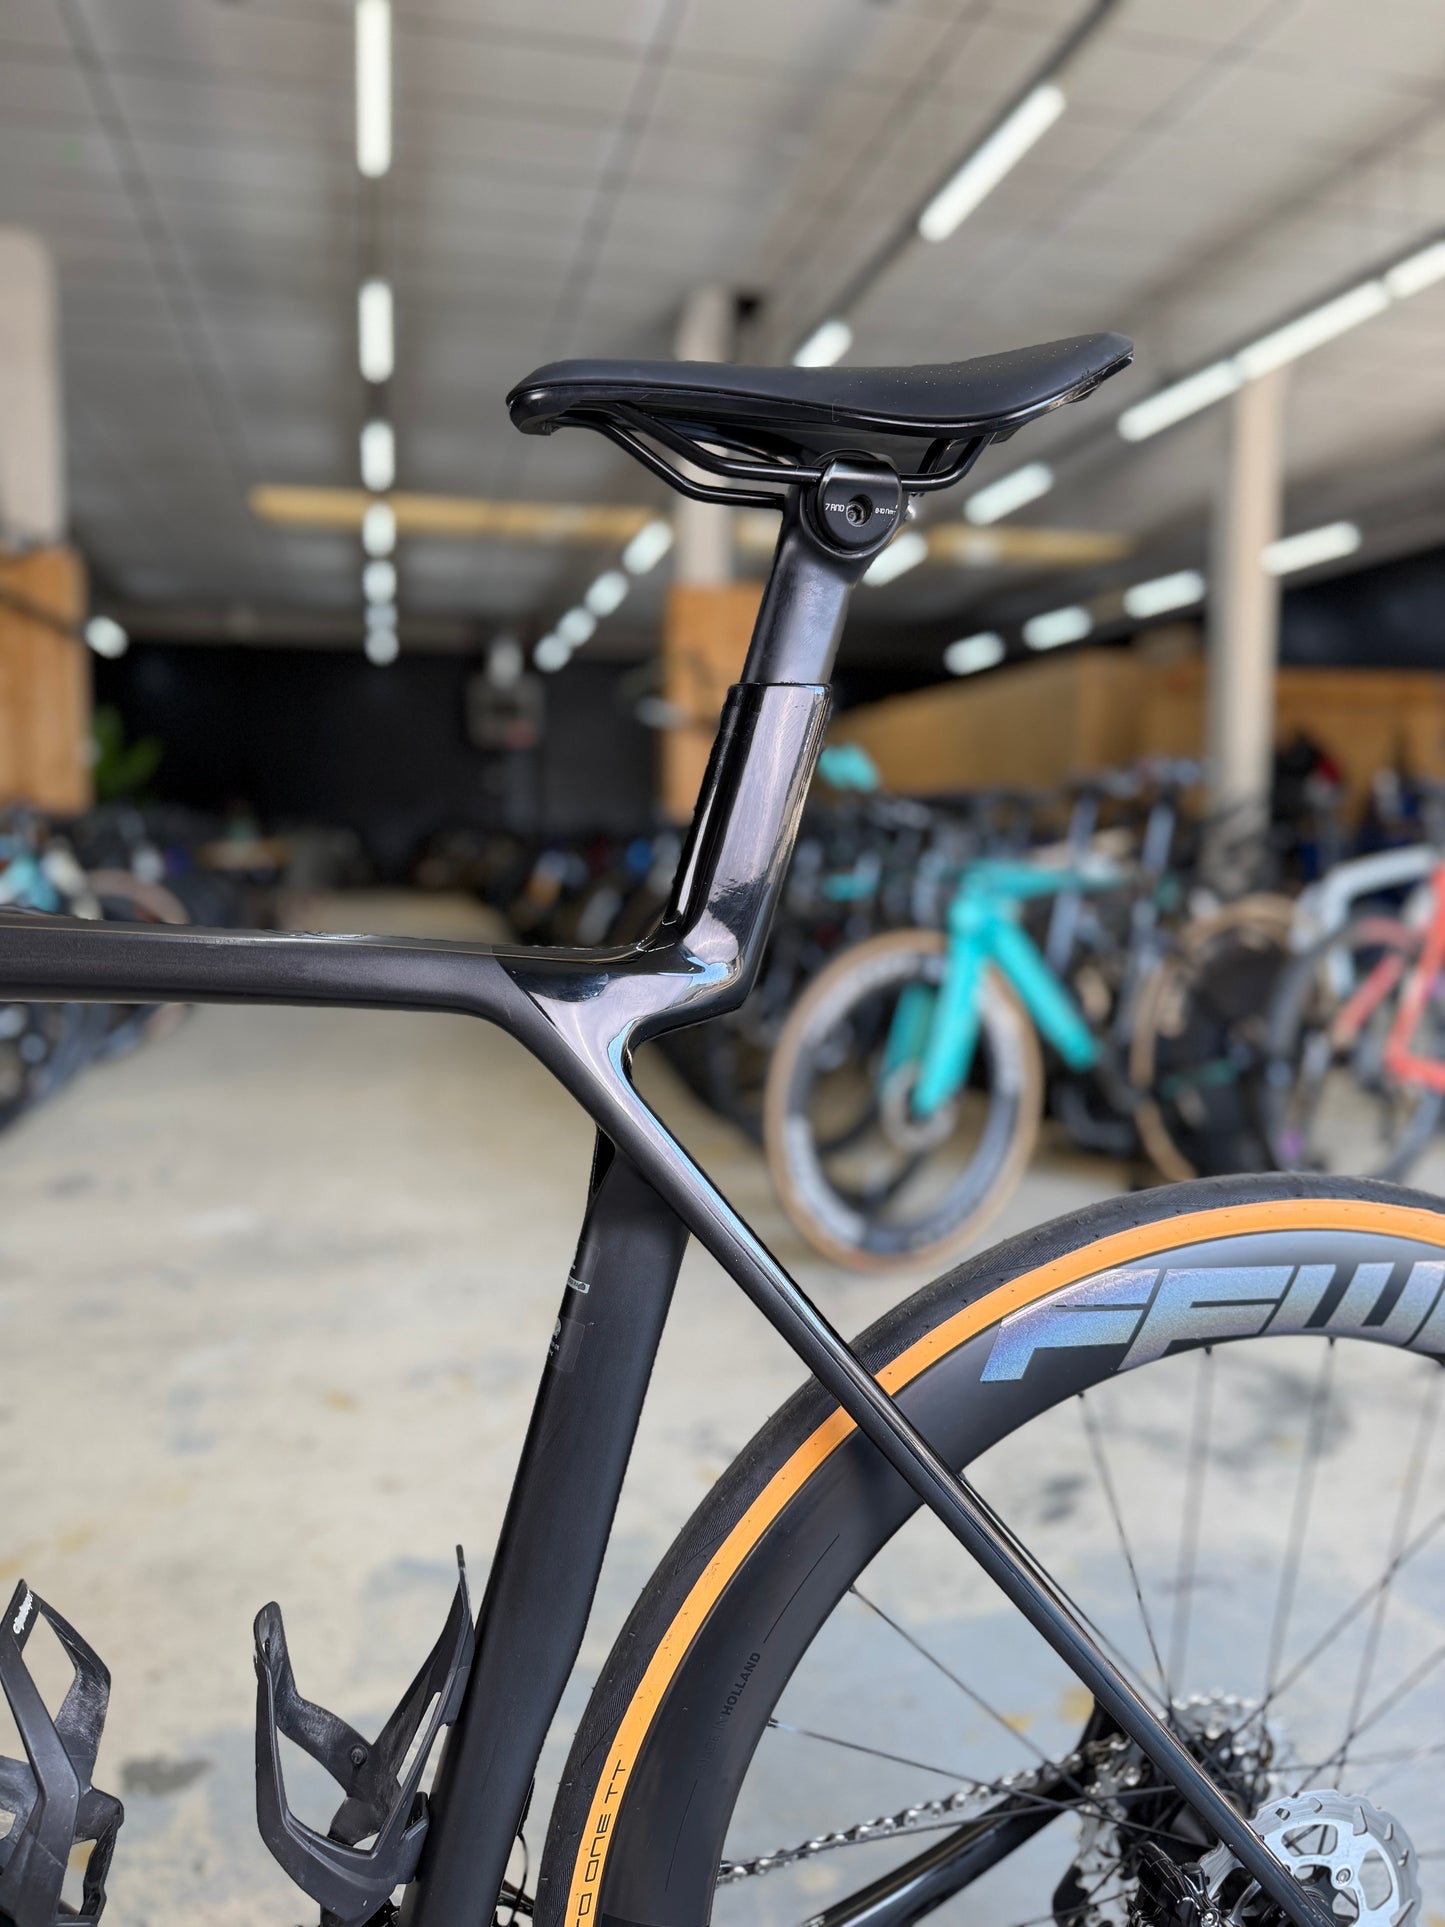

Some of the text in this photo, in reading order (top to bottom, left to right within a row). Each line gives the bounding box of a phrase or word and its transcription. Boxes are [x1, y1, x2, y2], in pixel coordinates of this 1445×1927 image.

[980, 1261, 1445, 1382] FFW
[721, 1652, 761, 1716] HOLLAND
[576, 1759, 626, 1927] O ONE TT
